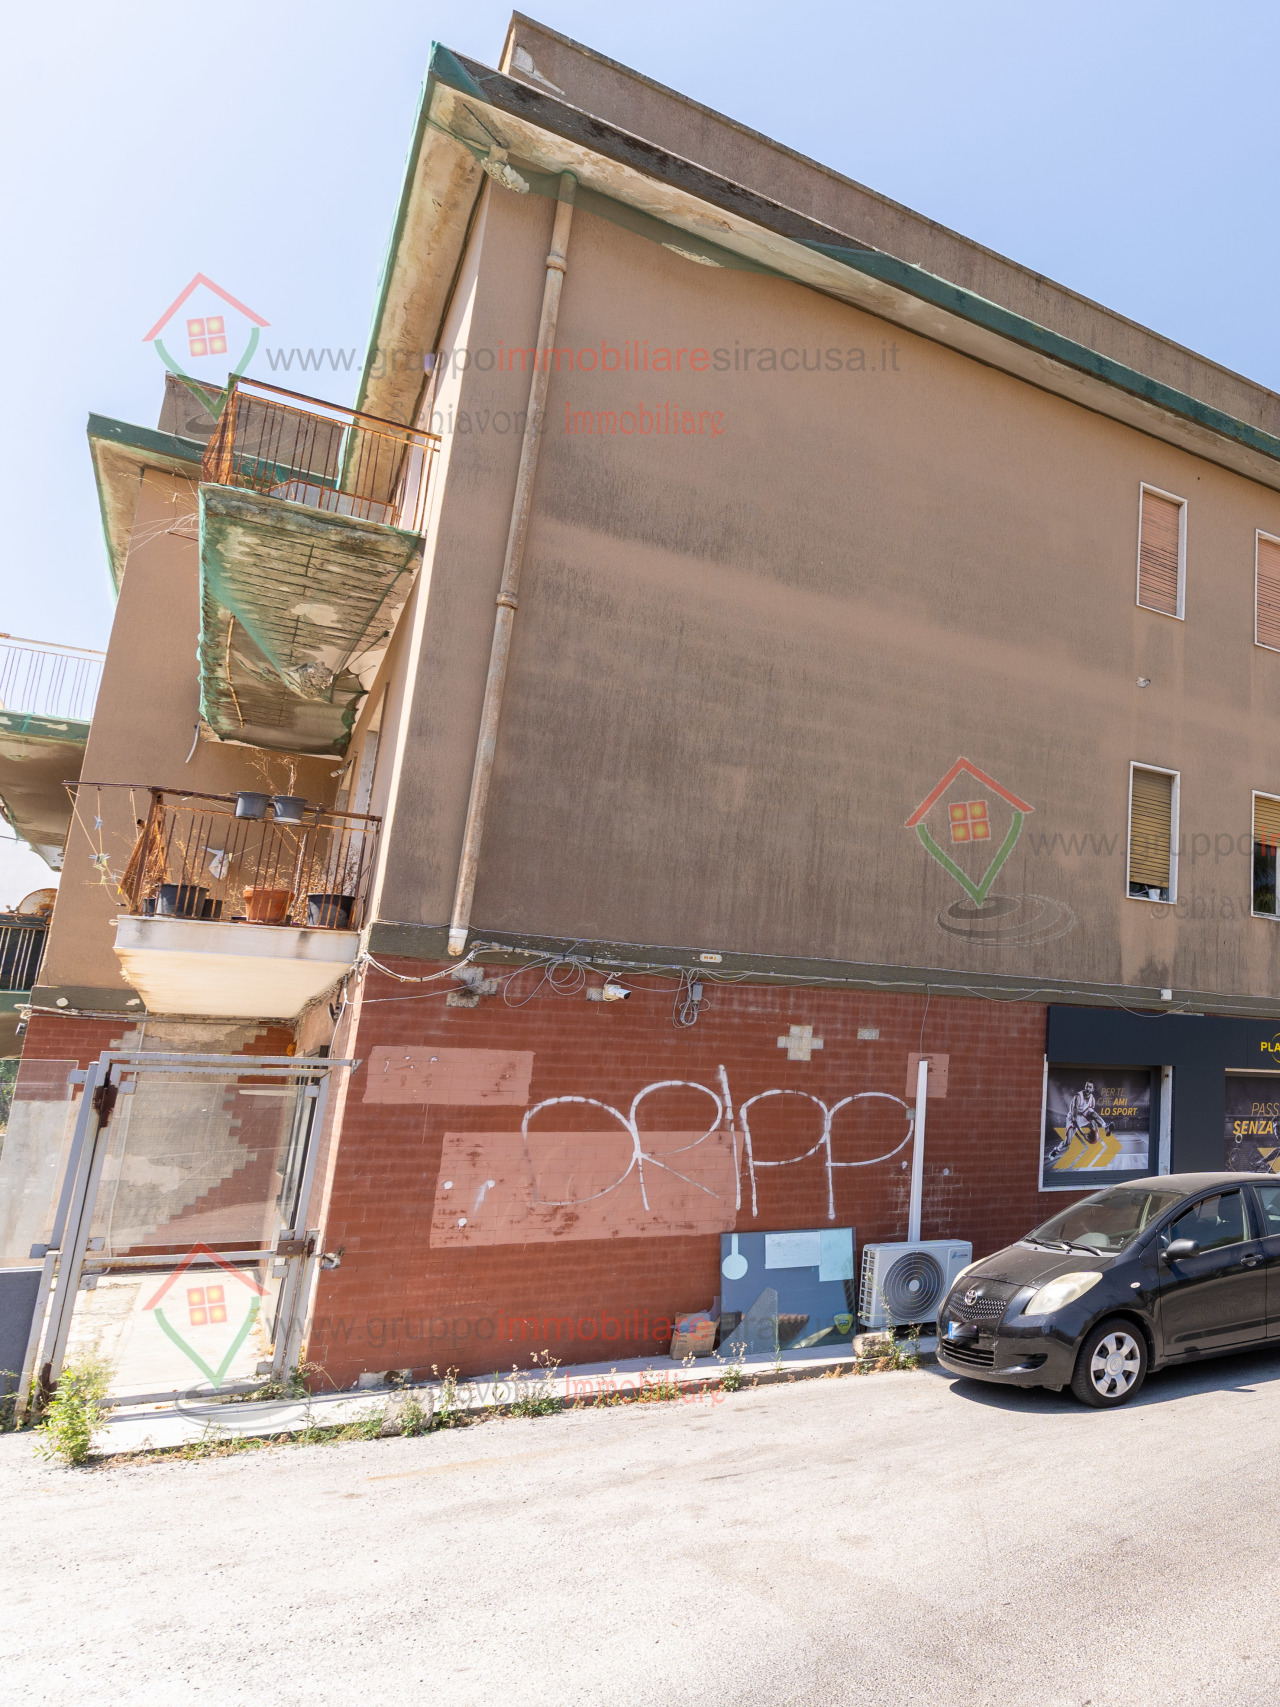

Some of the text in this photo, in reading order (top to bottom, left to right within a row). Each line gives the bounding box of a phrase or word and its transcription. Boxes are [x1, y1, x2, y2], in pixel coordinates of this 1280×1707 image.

[1101, 1088, 1125, 1096] PER TE
[1113, 1098, 1128, 1106] AMI
[1100, 1107, 1138, 1116] LO SPORT
[1232, 1120, 1273, 1135] SENZA
